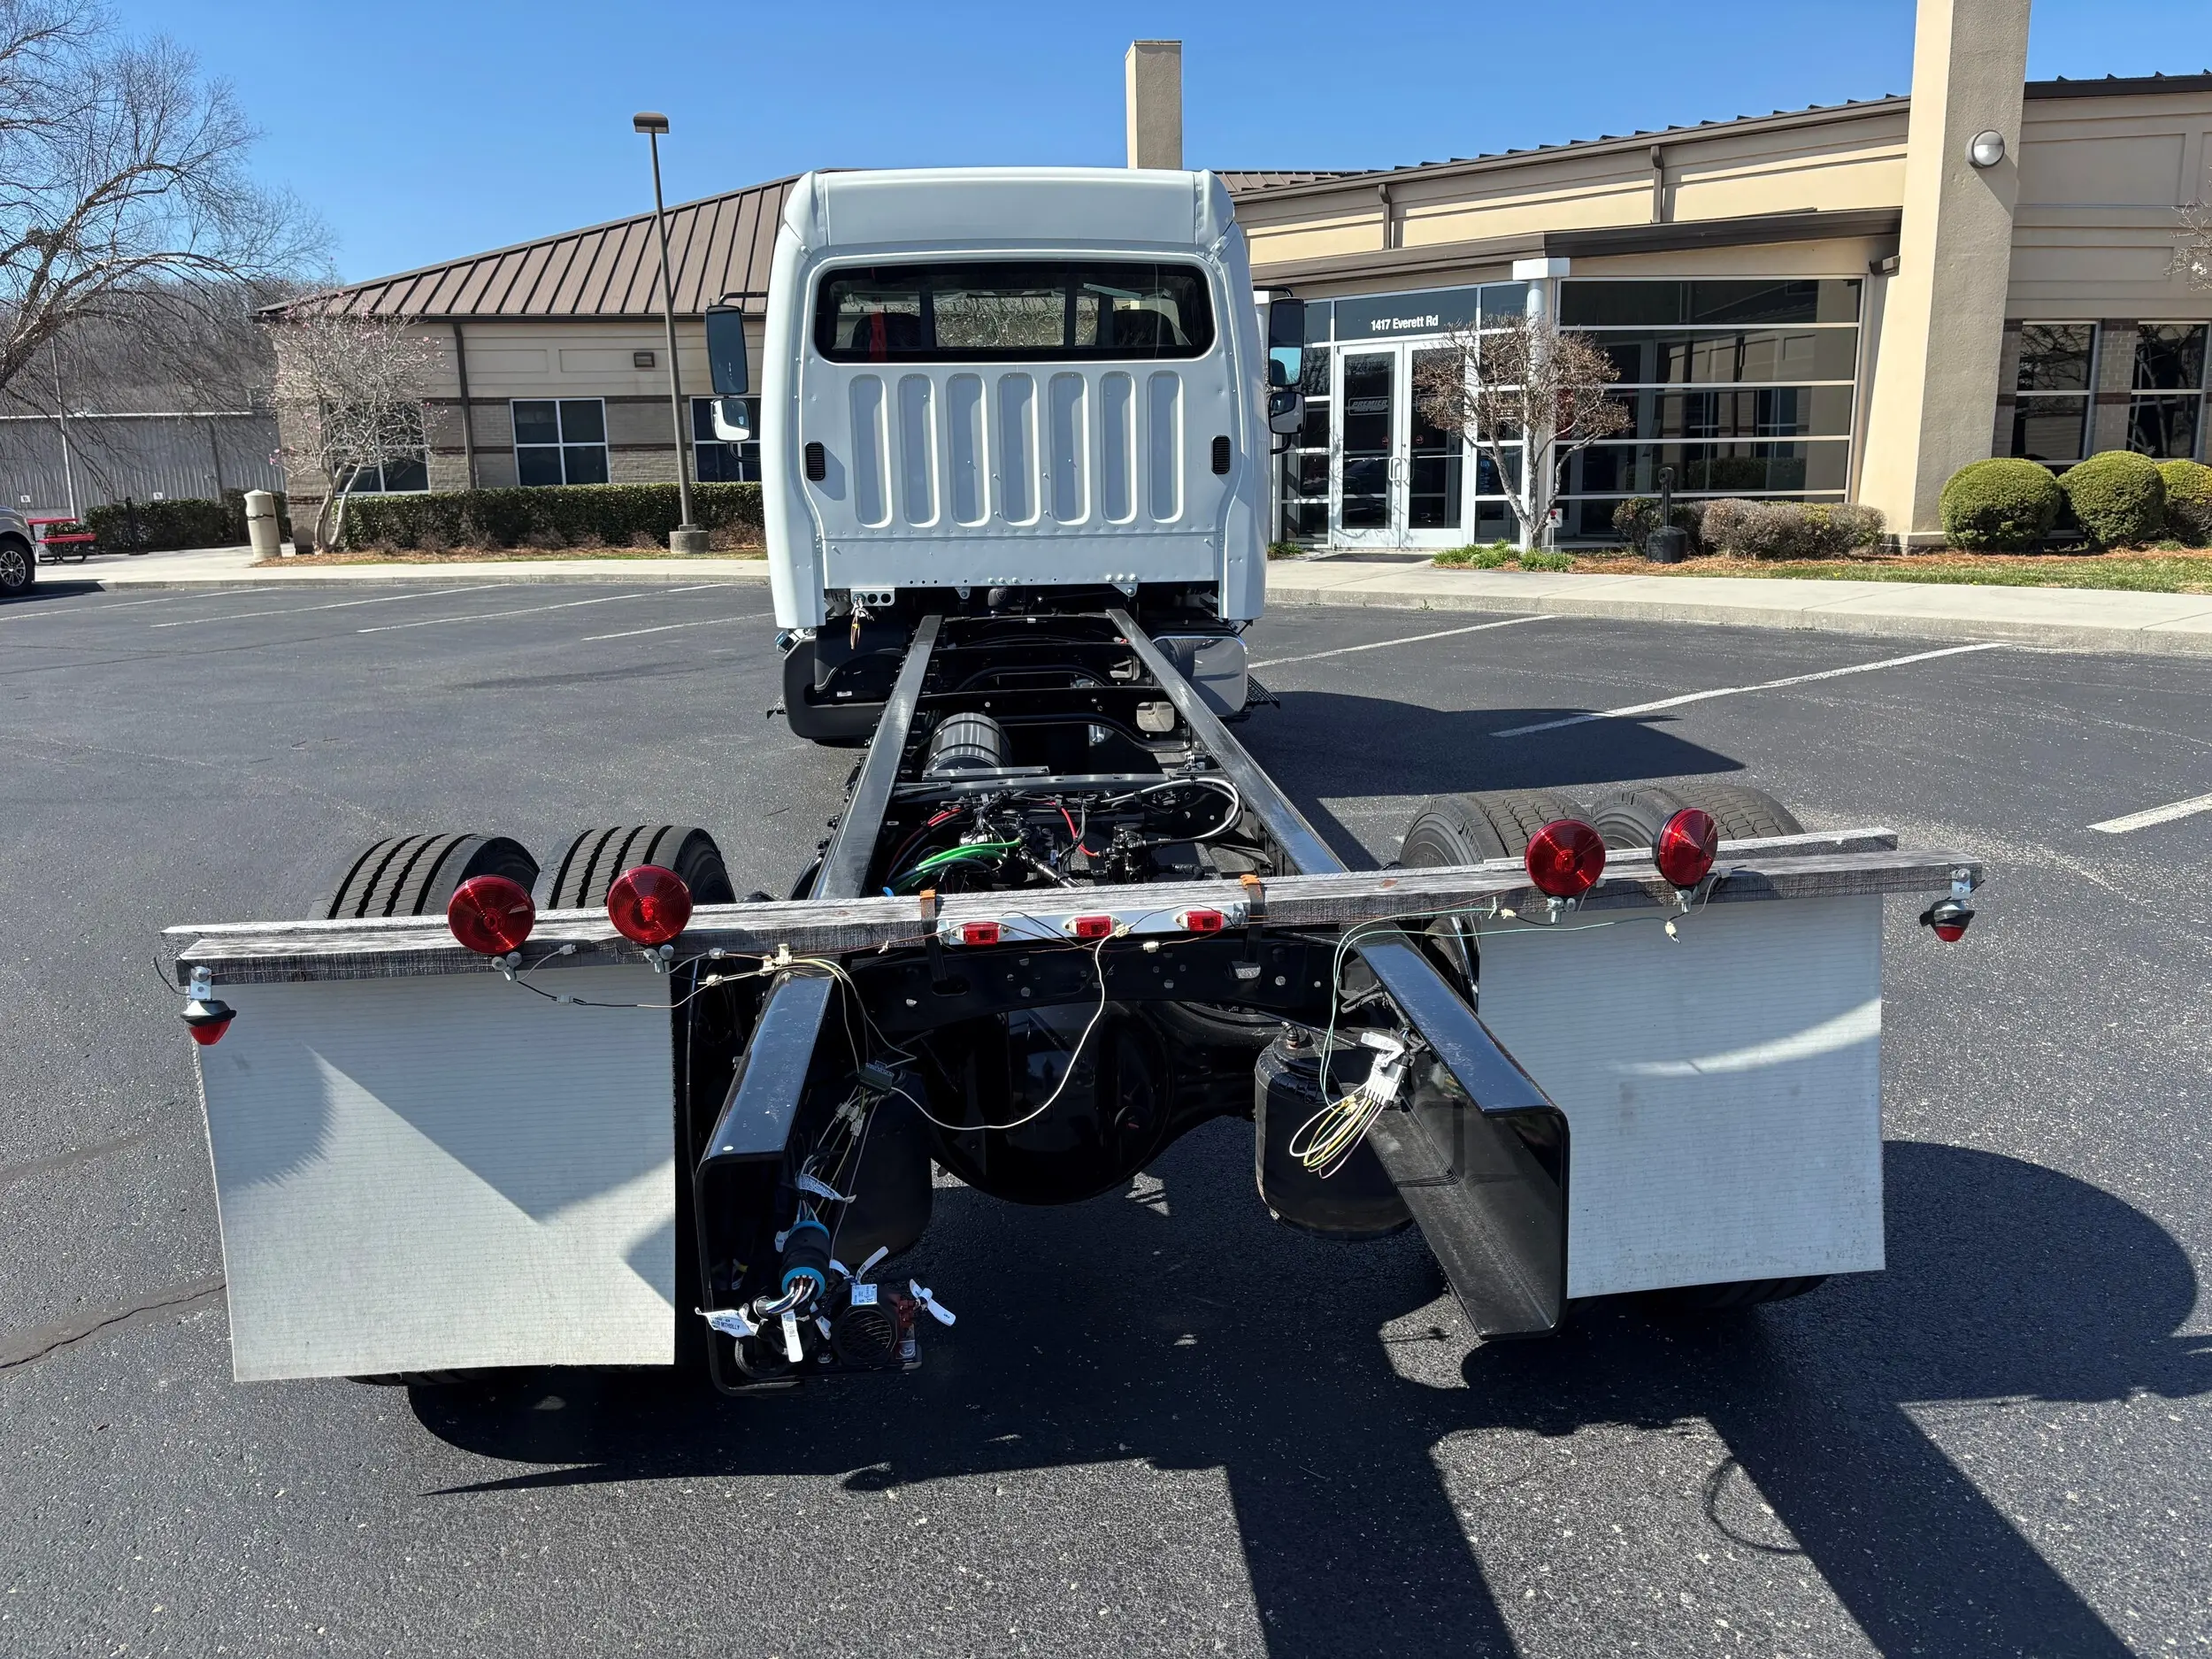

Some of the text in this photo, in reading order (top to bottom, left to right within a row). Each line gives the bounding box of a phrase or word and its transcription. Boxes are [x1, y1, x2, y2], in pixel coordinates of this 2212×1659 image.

[1371, 314, 1439, 331] 1417 Everett Rd
